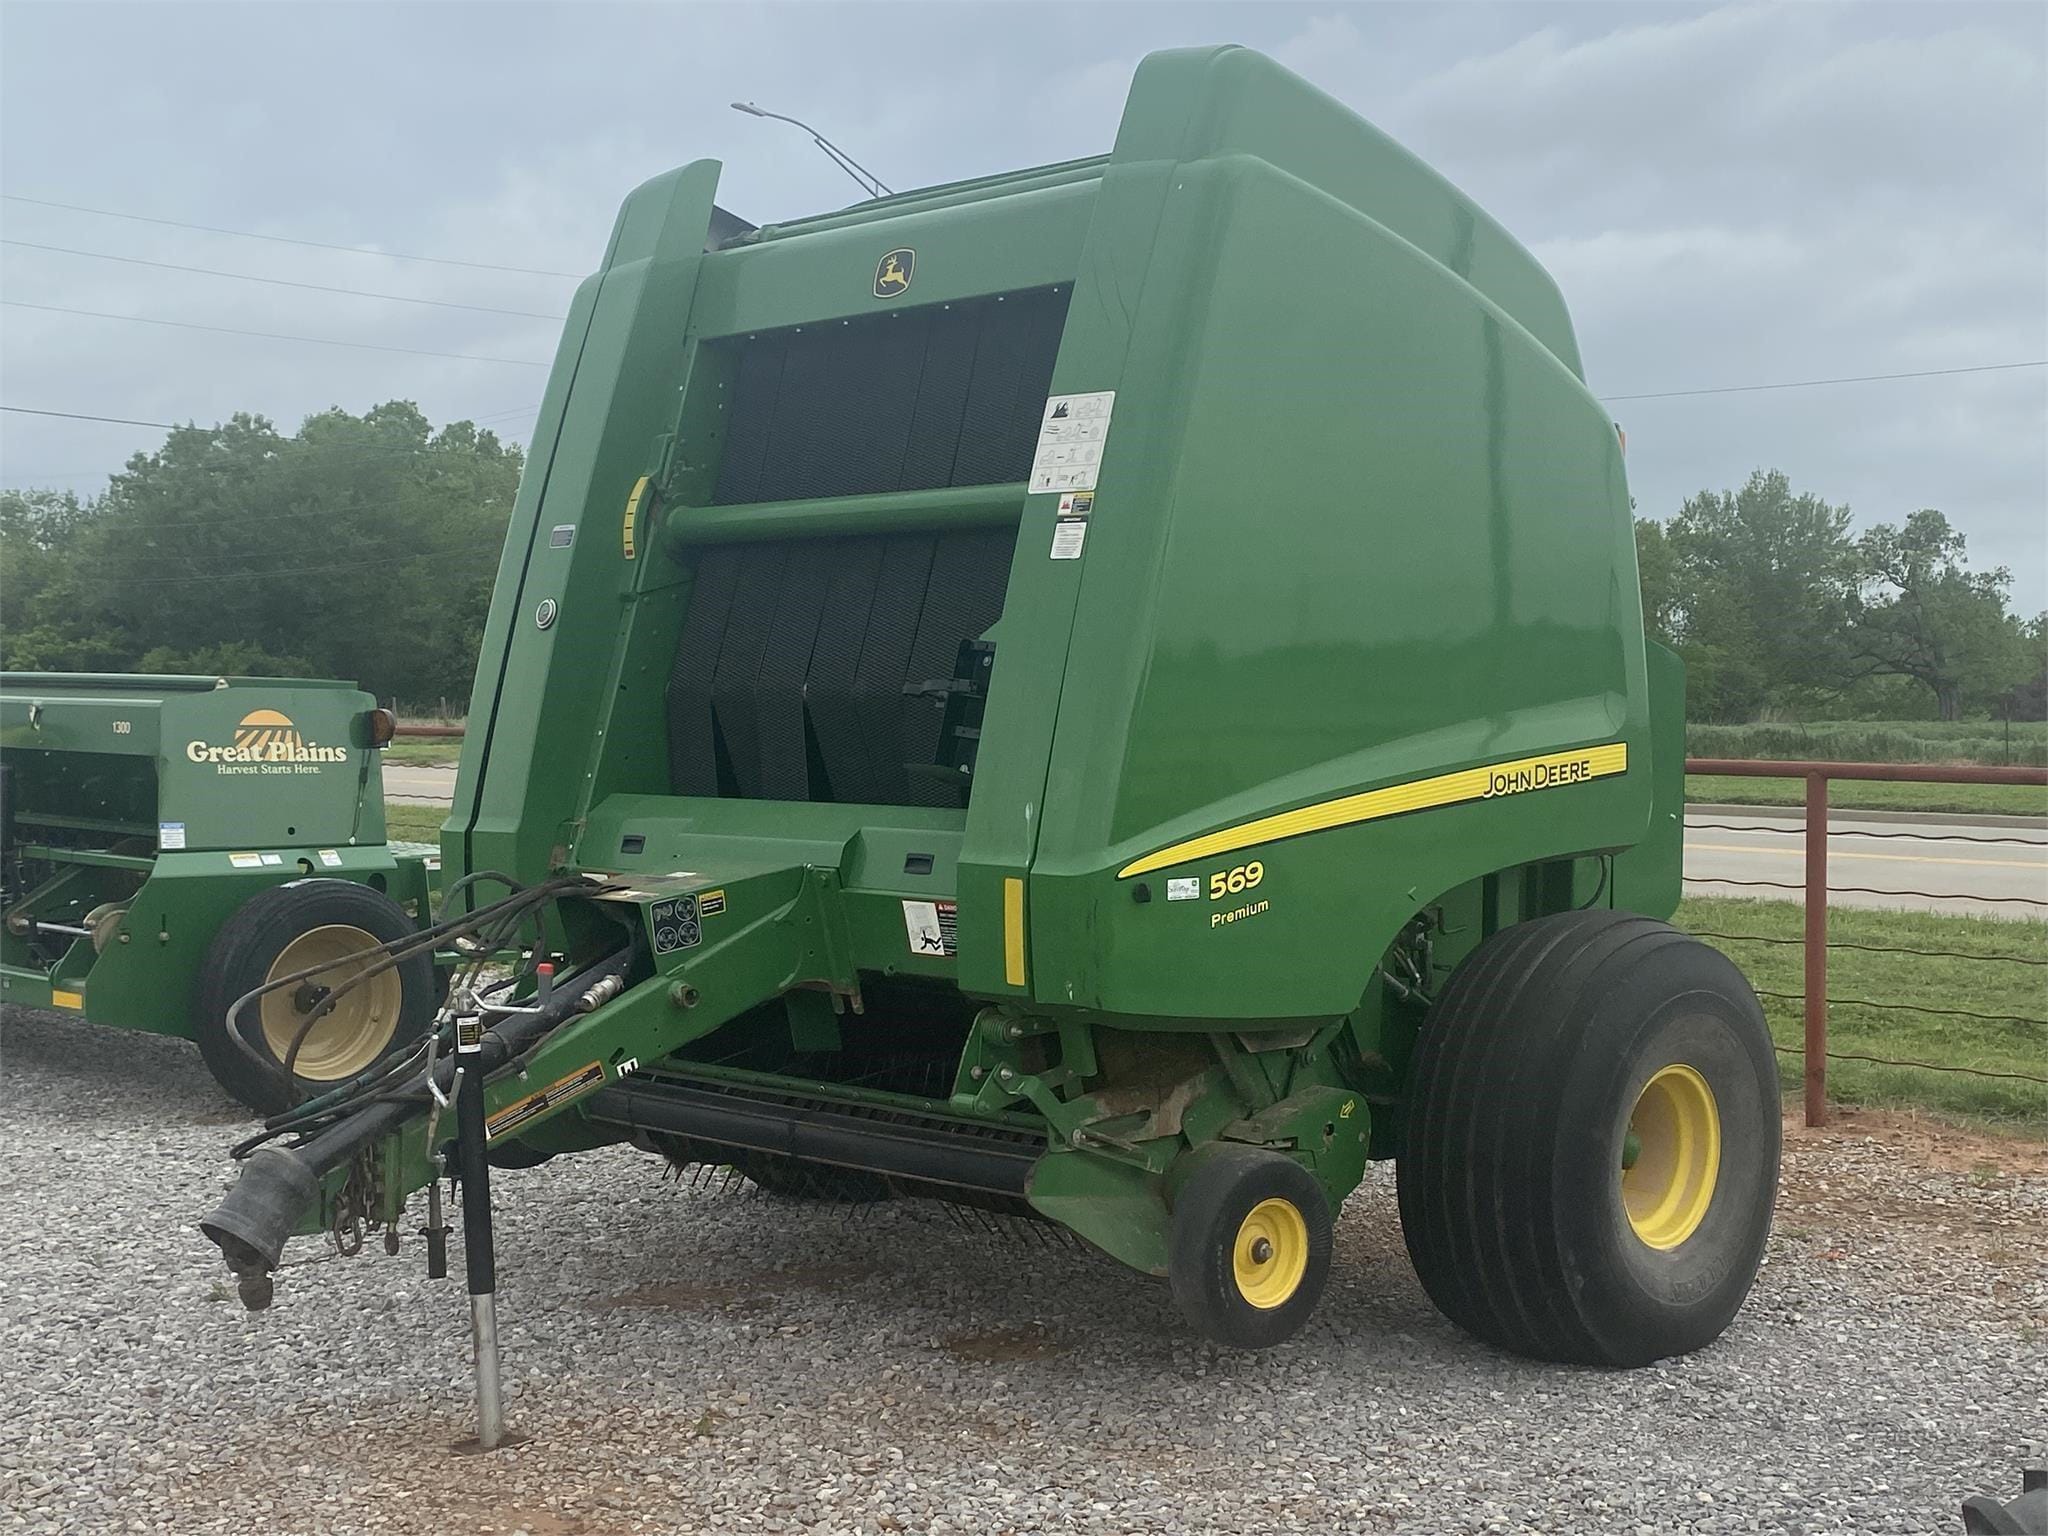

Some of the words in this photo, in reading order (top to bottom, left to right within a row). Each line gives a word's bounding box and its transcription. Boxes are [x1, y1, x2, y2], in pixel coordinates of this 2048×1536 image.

[112, 721, 131, 734] 1300
[186, 740, 264, 763] Great
[267, 741, 348, 763] Plains
[217, 764, 259, 775] Harvest
[260, 764, 292, 775] Starts
[294, 764, 322, 775] Here.
[1482, 770, 1532, 797] JOHN
[1534, 759, 1591, 787] DEERE
[1209, 860, 1265, 901] 569
[1210, 899, 1270, 929] Premium
